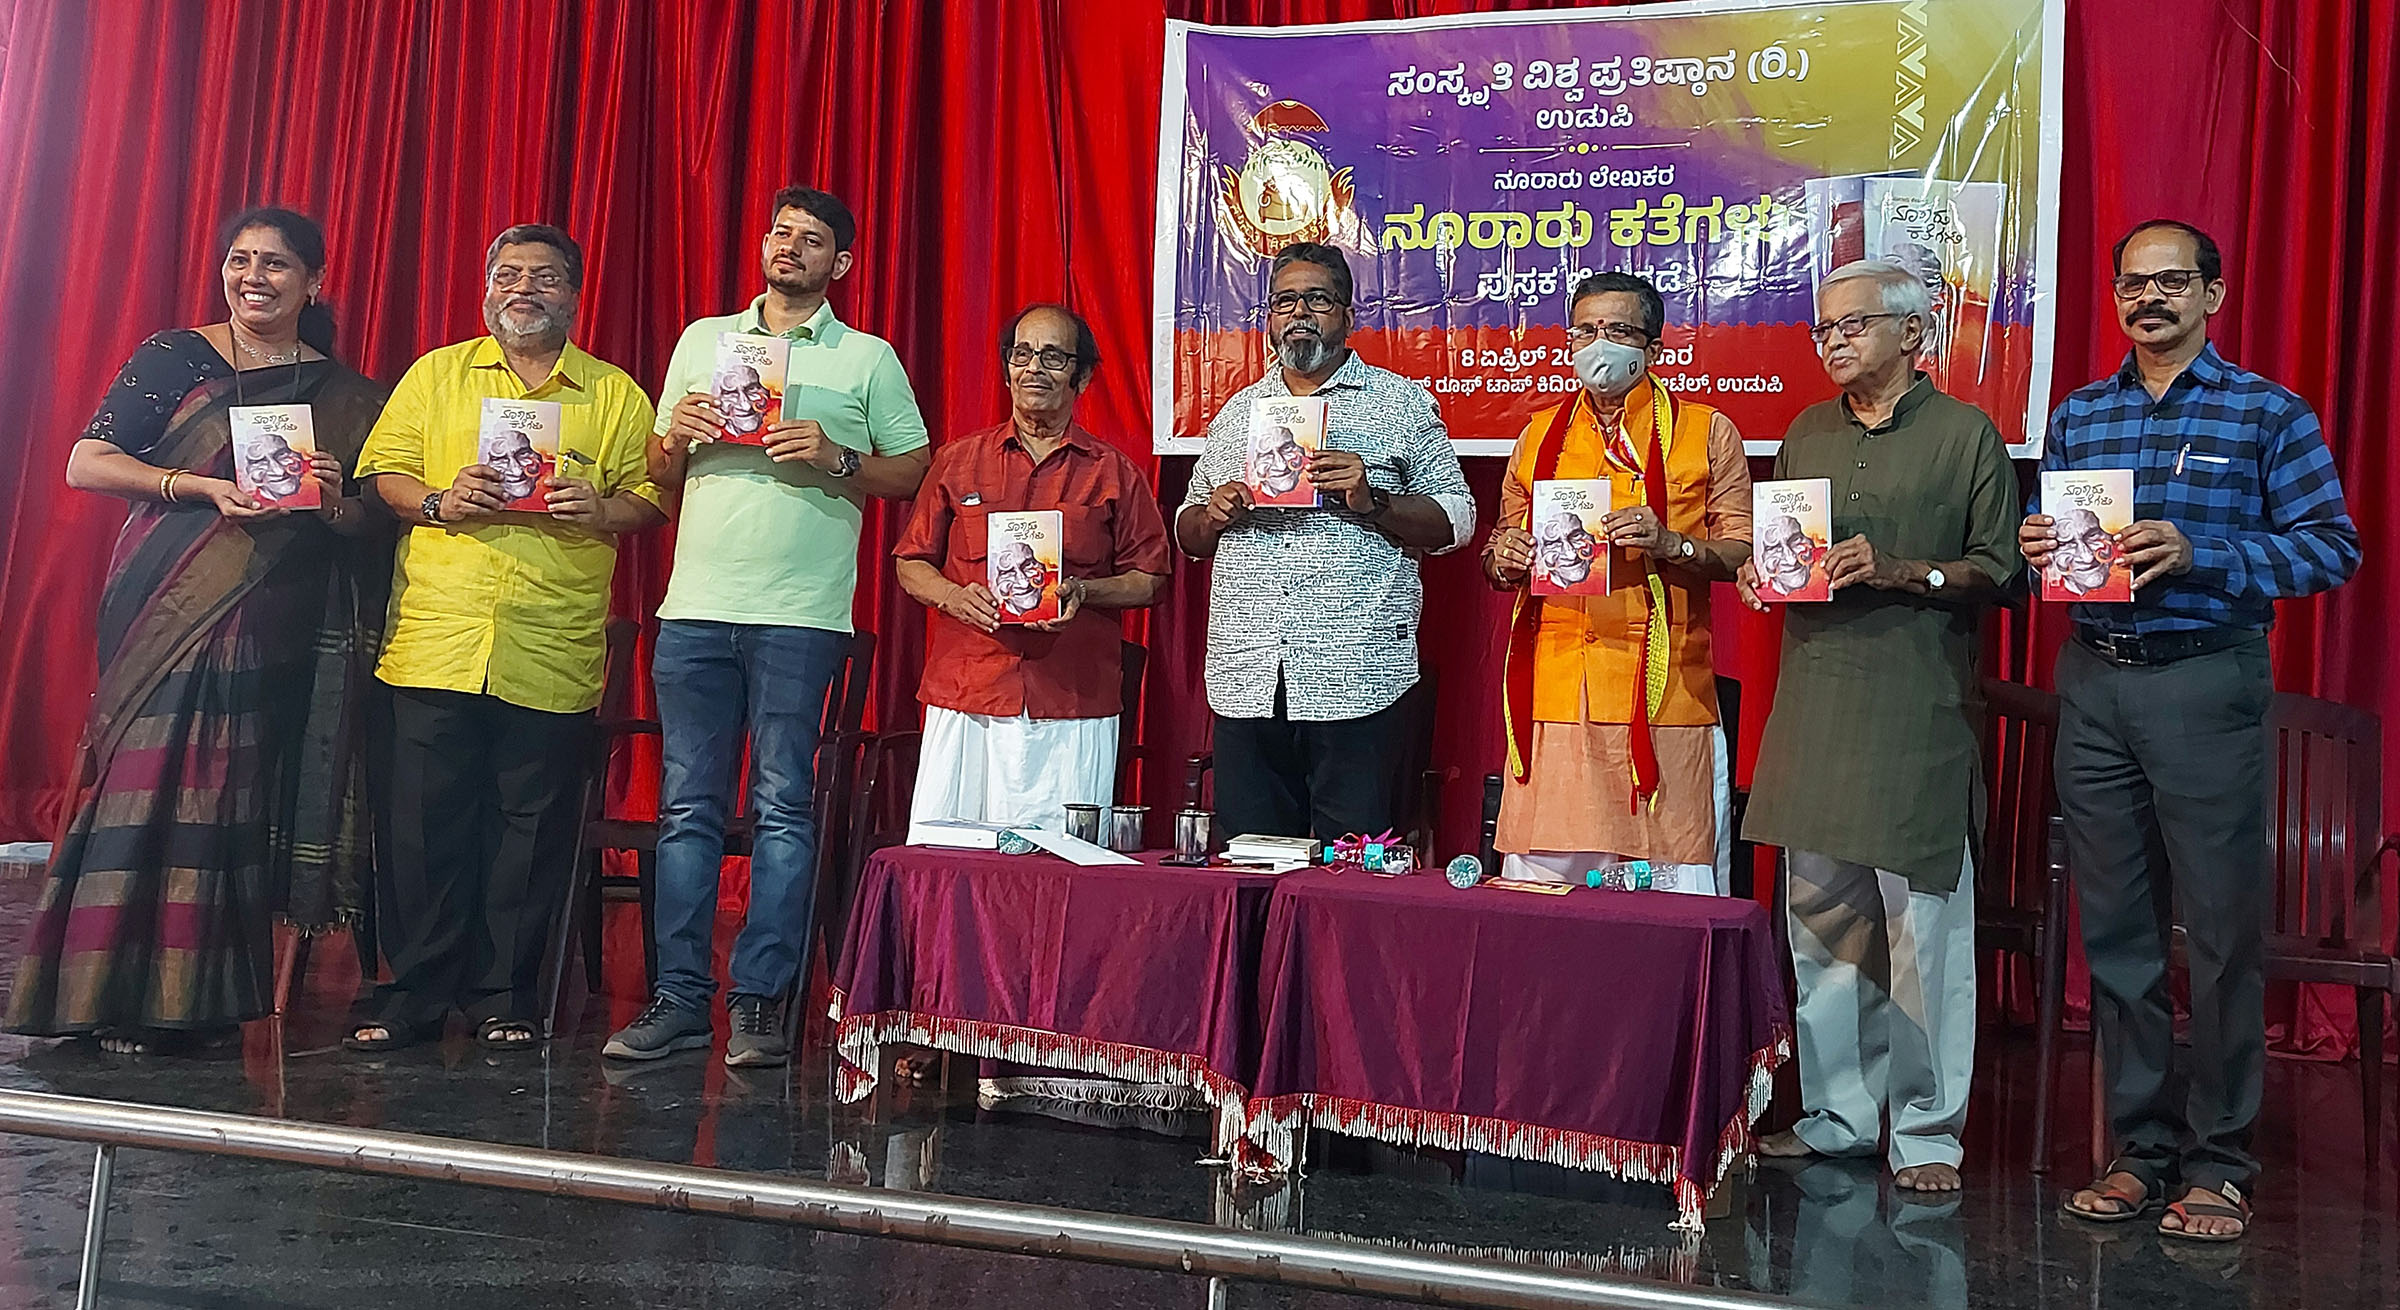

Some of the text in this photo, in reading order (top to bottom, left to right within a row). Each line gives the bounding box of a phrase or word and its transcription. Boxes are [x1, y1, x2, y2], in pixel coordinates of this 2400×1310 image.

[1387, 44, 1811, 111] ಸಂಸ್ಕೃತಿ ವಿಶ್ವ ಪ್ರತಿಷ್ಠಾನ (ರಿ.)
[1535, 103, 1635, 131] ಉಡುಪಿ
[1493, 163, 1676, 192] ನೂರಾರು ಲೇಖಕರ
[1382, 200, 1594, 252] ನೂರಾರು
[1477, 265, 1558, 306] ಪುಸ್ತಕ
[1461, 348, 1475, 367] 8
[1480, 345, 1548, 373] ಏಪ್ರಿಲ್
[1435, 374, 1483, 397] ರೂಫ್
[1486, 374, 1533, 393] ಟಾಪ್
[1717, 373, 1785, 393] ಉಡುಪಿ
